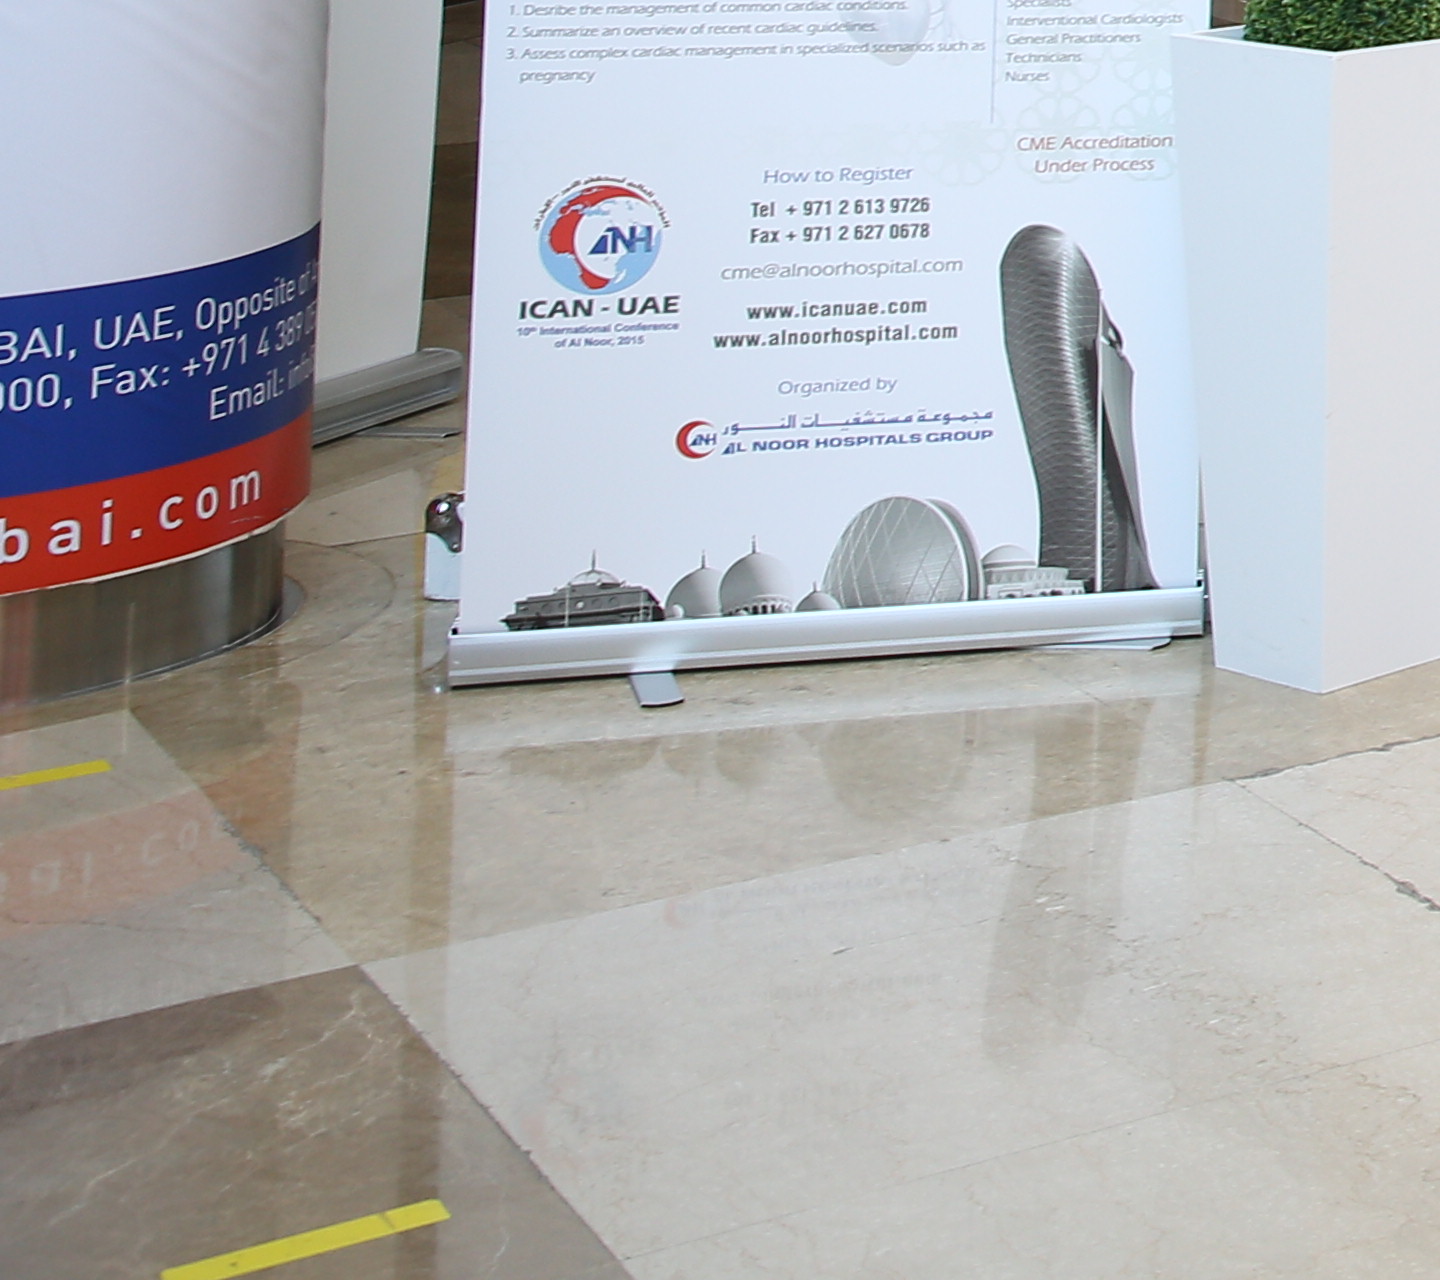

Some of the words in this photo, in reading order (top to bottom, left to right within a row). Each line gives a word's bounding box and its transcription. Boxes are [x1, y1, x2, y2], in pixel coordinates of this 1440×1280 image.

[1017, 137, 1055, 151] CME
[1059, 134, 1173, 150] Accreditation
[763, 168, 809, 184] How
[814, 169, 835, 183] to
[839, 165, 915, 187] Register
[1035, 159, 1087, 174] Under
[1092, 157, 1155, 172] Process
[750, 200, 776, 218] Tel
[803, 199, 832, 217] 971
[838, 199, 850, 215] 2
[854, 197, 885, 215] 613
[889, 196, 931, 213] 9726
[750, 226, 780, 244] Fax
[802, 225, 832, 242] 971
[838, 224, 850, 241] 2
[853, 224, 884, 240] 627
[889, 222, 930, 239] 0678
[721, 258, 964, 282] cme@alnoorhospital.com
[93, 305, 184, 351] UAE,
[195, 276, 296, 335] Opposite
[518, 298, 594, 321] ICAN
[617, 295, 681, 316] UAE
[747, 298, 928, 321] www.icanuae.com
[713, 324, 959, 349] www.alnoorhospital.com
[90, 362, 171, 400] Fax:
[181, 333, 248, 377] +971
[256, 326, 270, 357] 4
[777, 377, 871, 397] Organized
[876, 377, 898, 394] by
[752, 438, 810, 453] NOOR
[814, 433, 923, 450] HOSPITALS
[925, 429, 994, 446] GROUP
